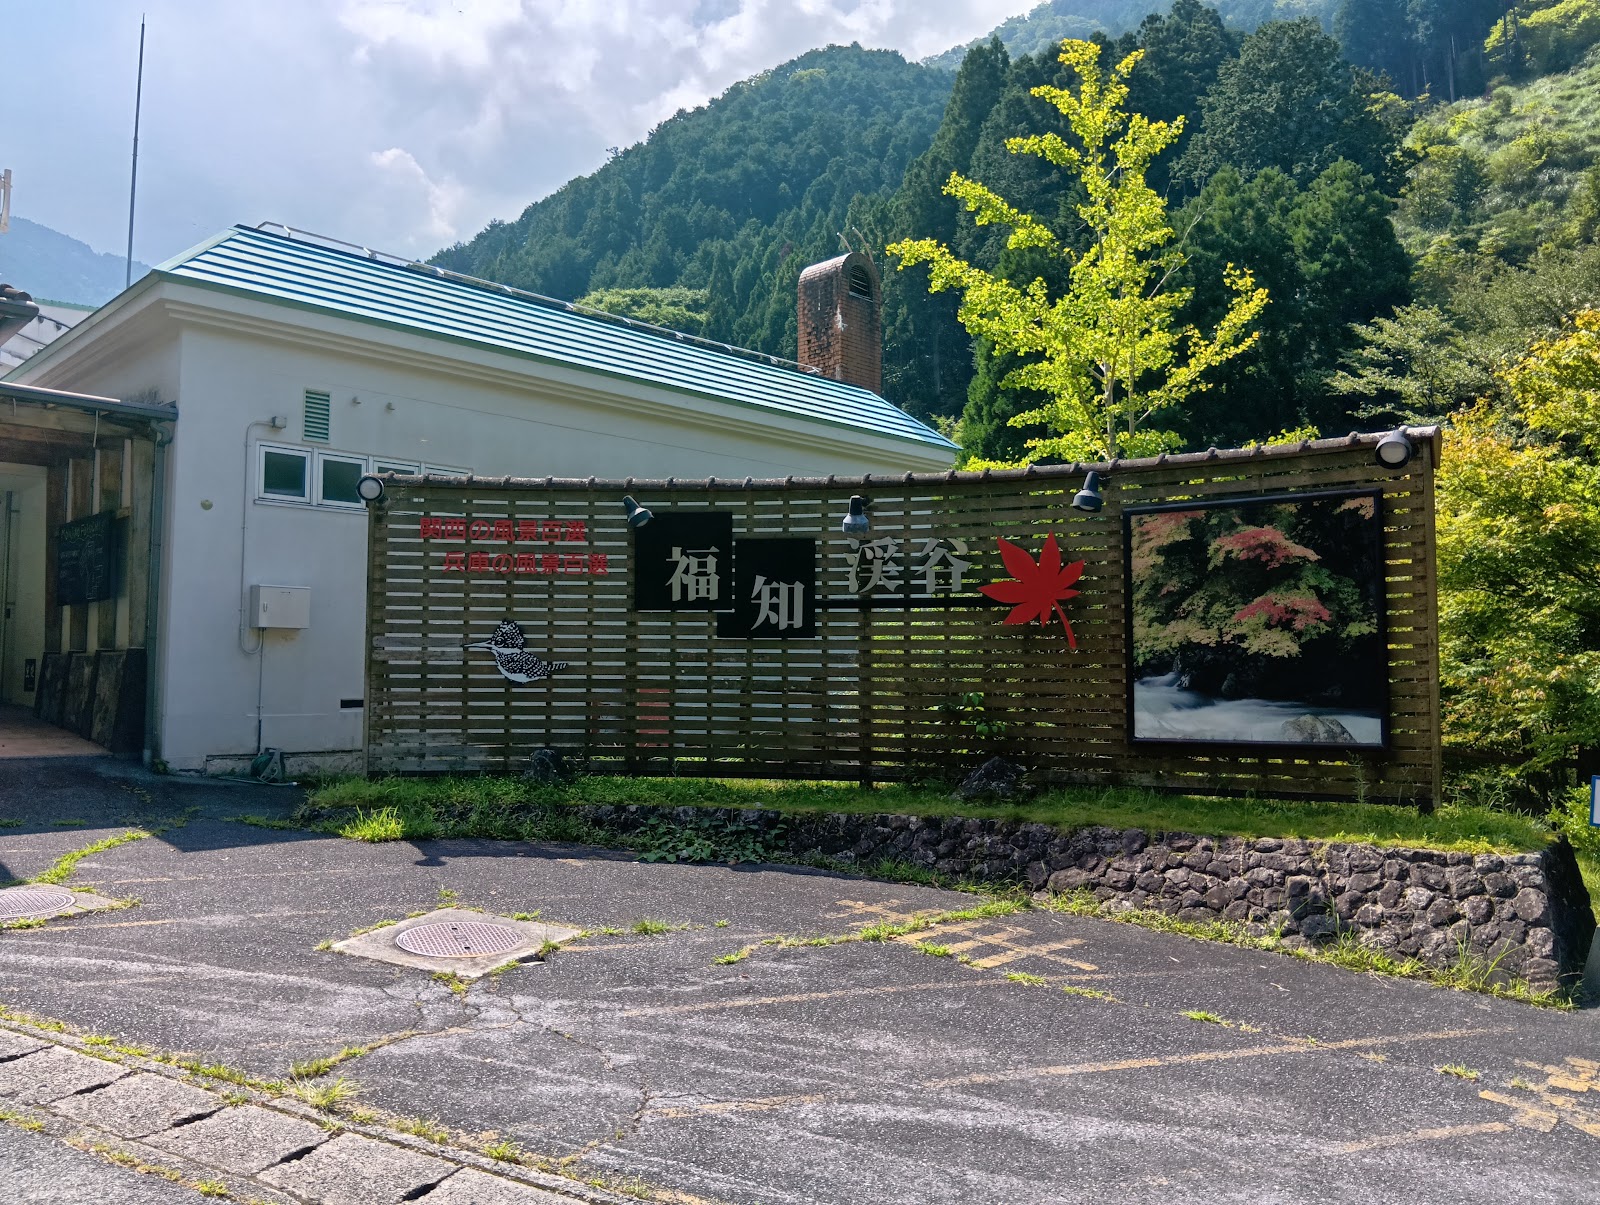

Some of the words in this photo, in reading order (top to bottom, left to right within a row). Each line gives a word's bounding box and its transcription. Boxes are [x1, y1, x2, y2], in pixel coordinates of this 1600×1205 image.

[420, 518, 586, 541] 関西の風景百選
[442, 552, 608, 575] 兵庫の風景百選
